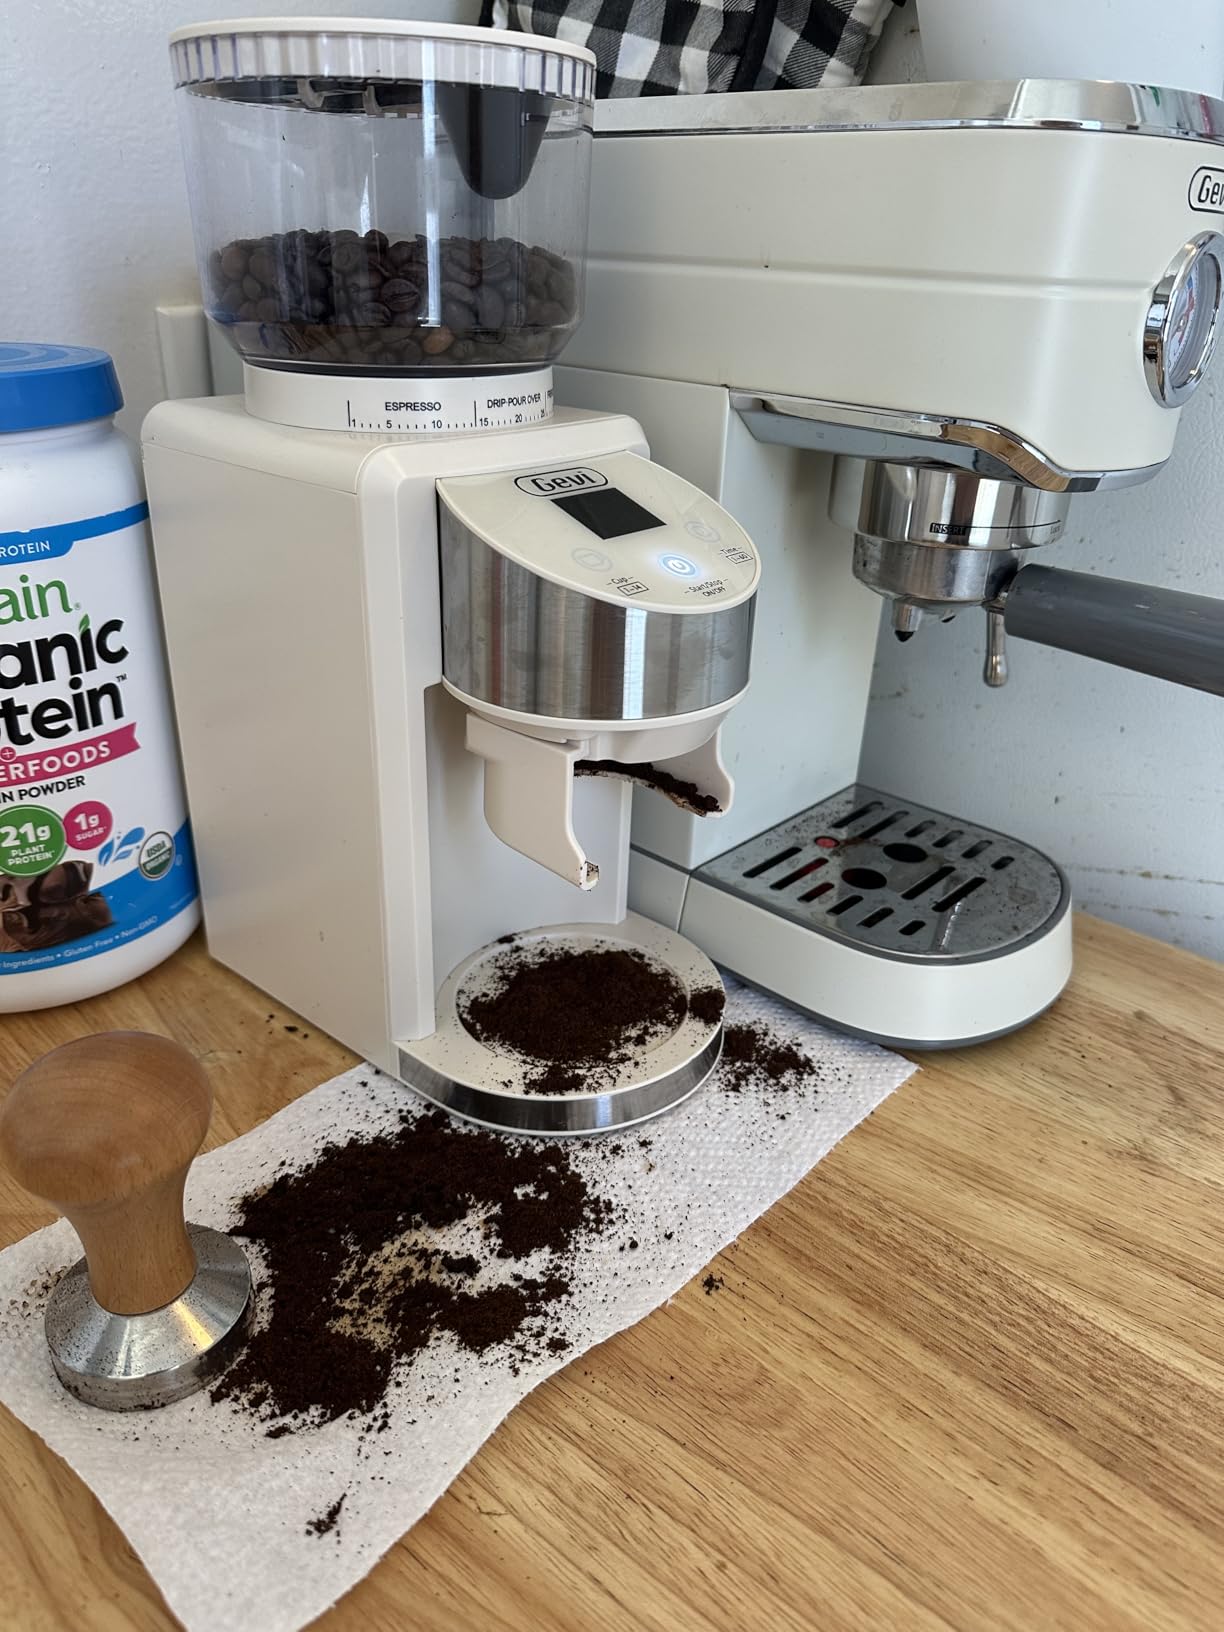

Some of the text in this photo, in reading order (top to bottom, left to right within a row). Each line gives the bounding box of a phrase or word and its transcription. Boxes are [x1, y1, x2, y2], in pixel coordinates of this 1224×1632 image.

[385, 401, 442, 412] ESPRESSO
[352, 418, 356, 428] 1
[386, 419, 393, 429] 5
[432, 419, 443, 429] 10
[480, 417, 489, 428] 15
[515, 413, 523, 423] 20
[530, 471, 597, 492] Gevi
[931, 523, 965, 535] INSERT
[0, 540, 51, 558] ROTEIN
[611, 576, 629, 586] Cup
[0, 614, 129, 690] anic
[0, 676, 124, 746] tein
[0, 775, 86, 804] N POWDER
[74, 813, 100, 830] 1g
[0, 822, 51, 848] 21g
[11, 844, 46, 857] PLANT
[3, 955, 55, 969] Ingredients
[63, 944, 94, 957] Gluten
